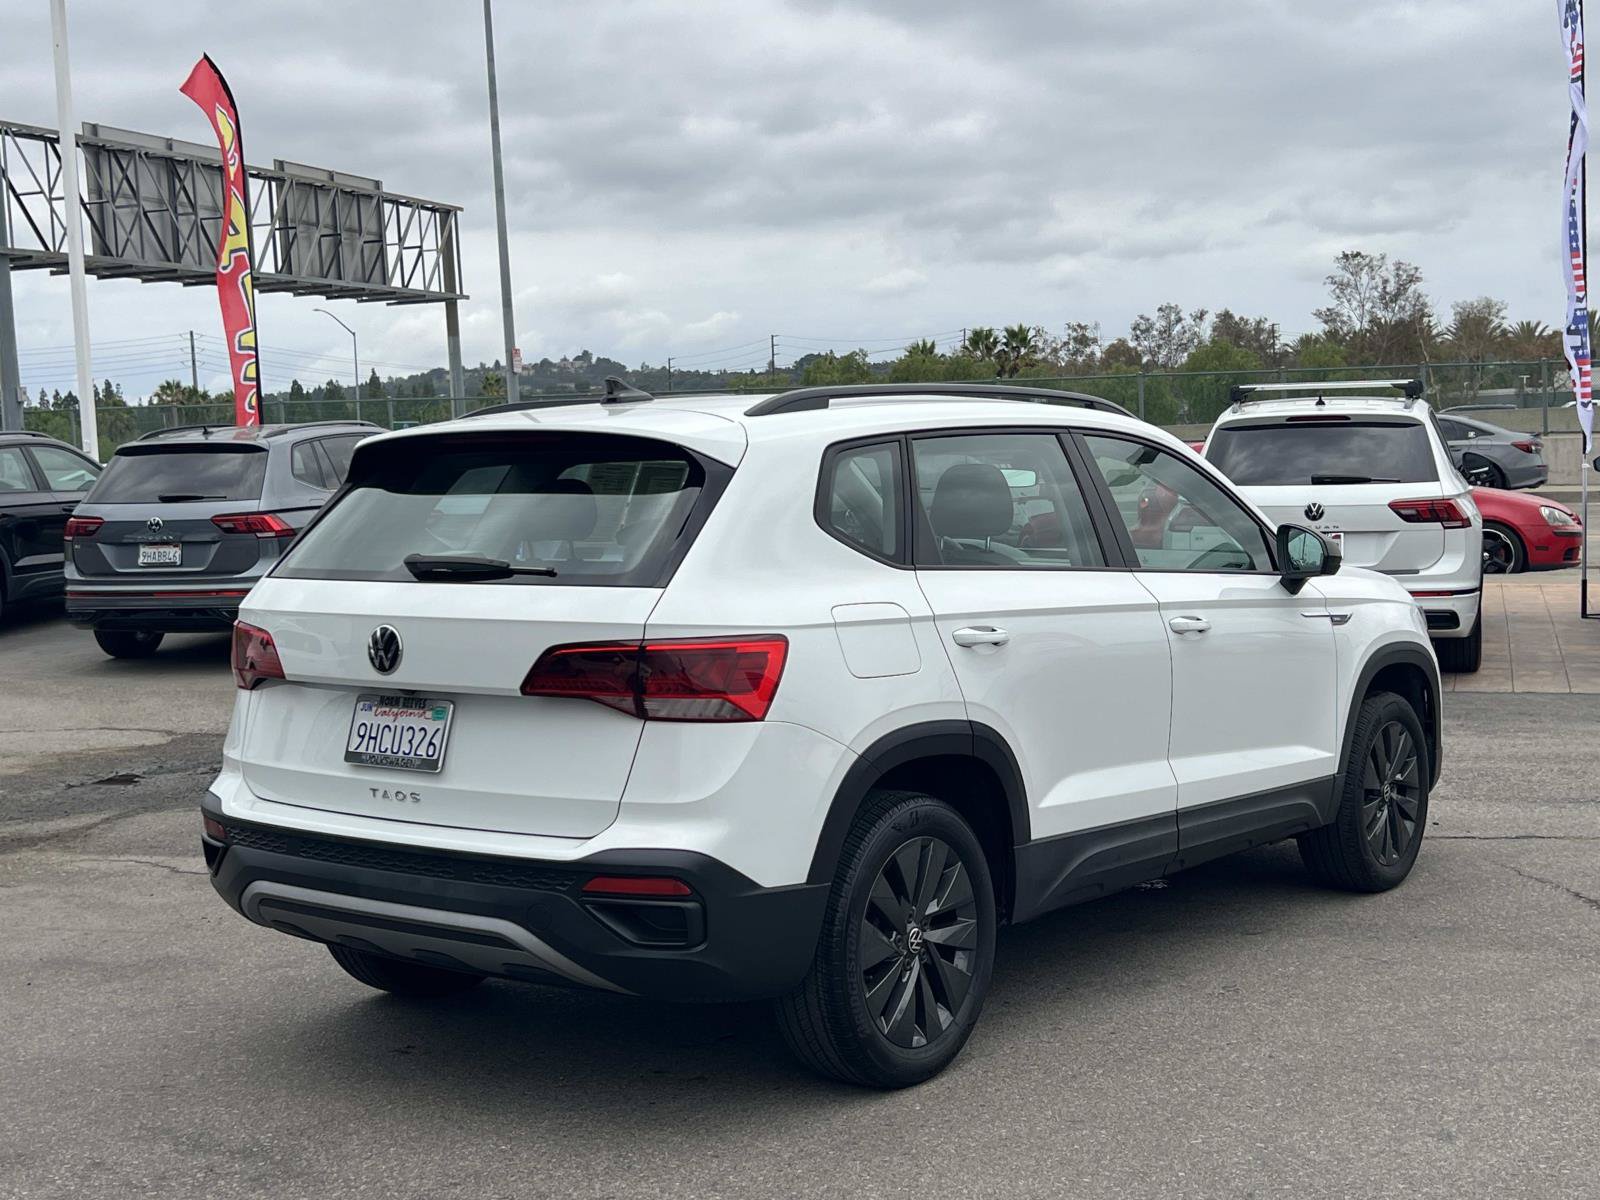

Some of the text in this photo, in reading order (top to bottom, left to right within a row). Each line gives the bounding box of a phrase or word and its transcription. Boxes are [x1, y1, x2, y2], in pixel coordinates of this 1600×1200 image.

[373, 706, 430, 722] California
[354, 722, 441, 758] 9HCU326
[366, 754, 418, 769] VOLKSWAGEN
[369, 787, 422, 803] TAOS
